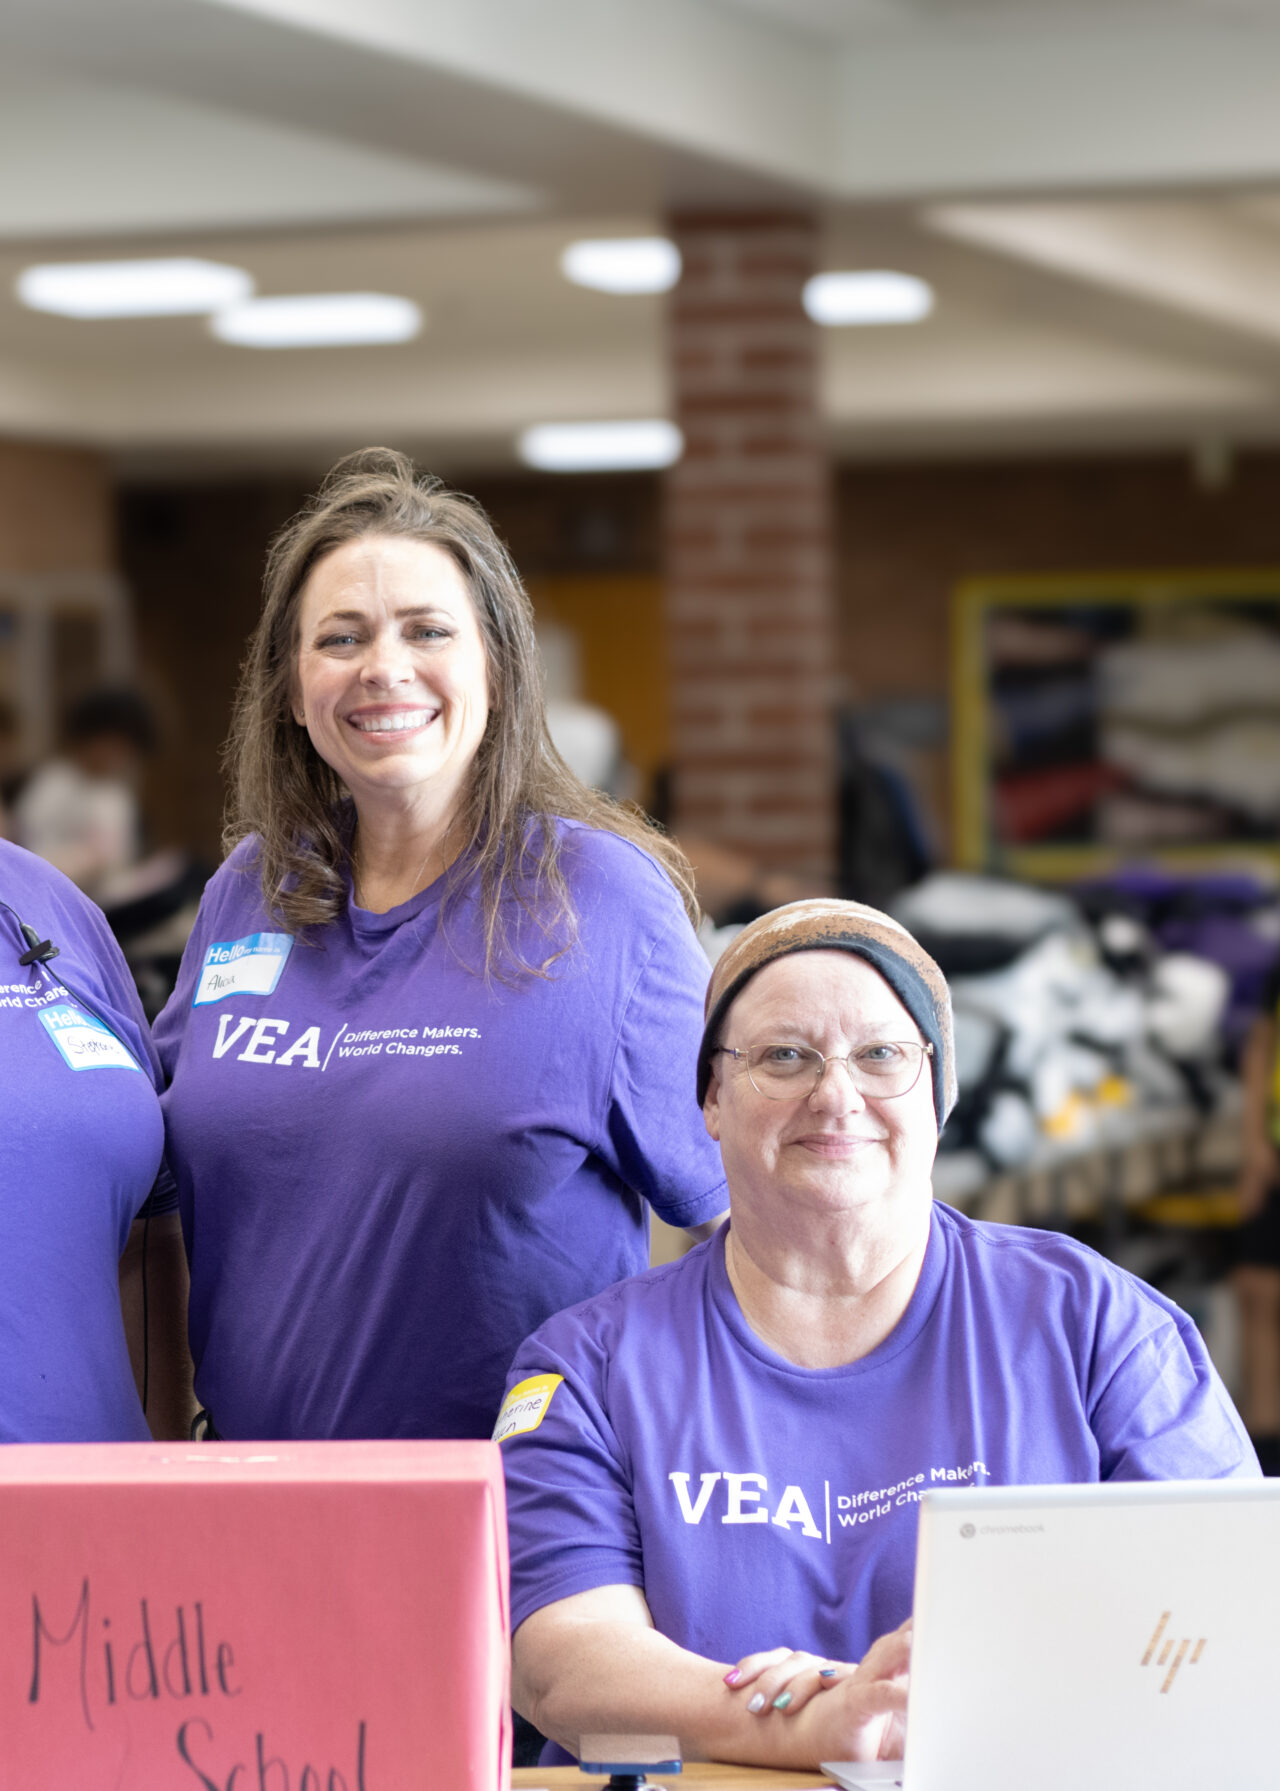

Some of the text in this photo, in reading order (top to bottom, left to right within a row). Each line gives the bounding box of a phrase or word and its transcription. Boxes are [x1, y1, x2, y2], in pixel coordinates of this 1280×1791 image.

[206, 944, 246, 964] Hello
[212, 1014, 321, 1068] VEA
[338, 1041, 463, 1058] World Changers.
[343, 1025, 482, 1044] Difference Makers.
[668, 1471, 822, 1539] VEA
[837, 1473, 925, 1510] Difference
[837, 1501, 891, 1528] World
[27, 1575, 244, 1732] Middle
